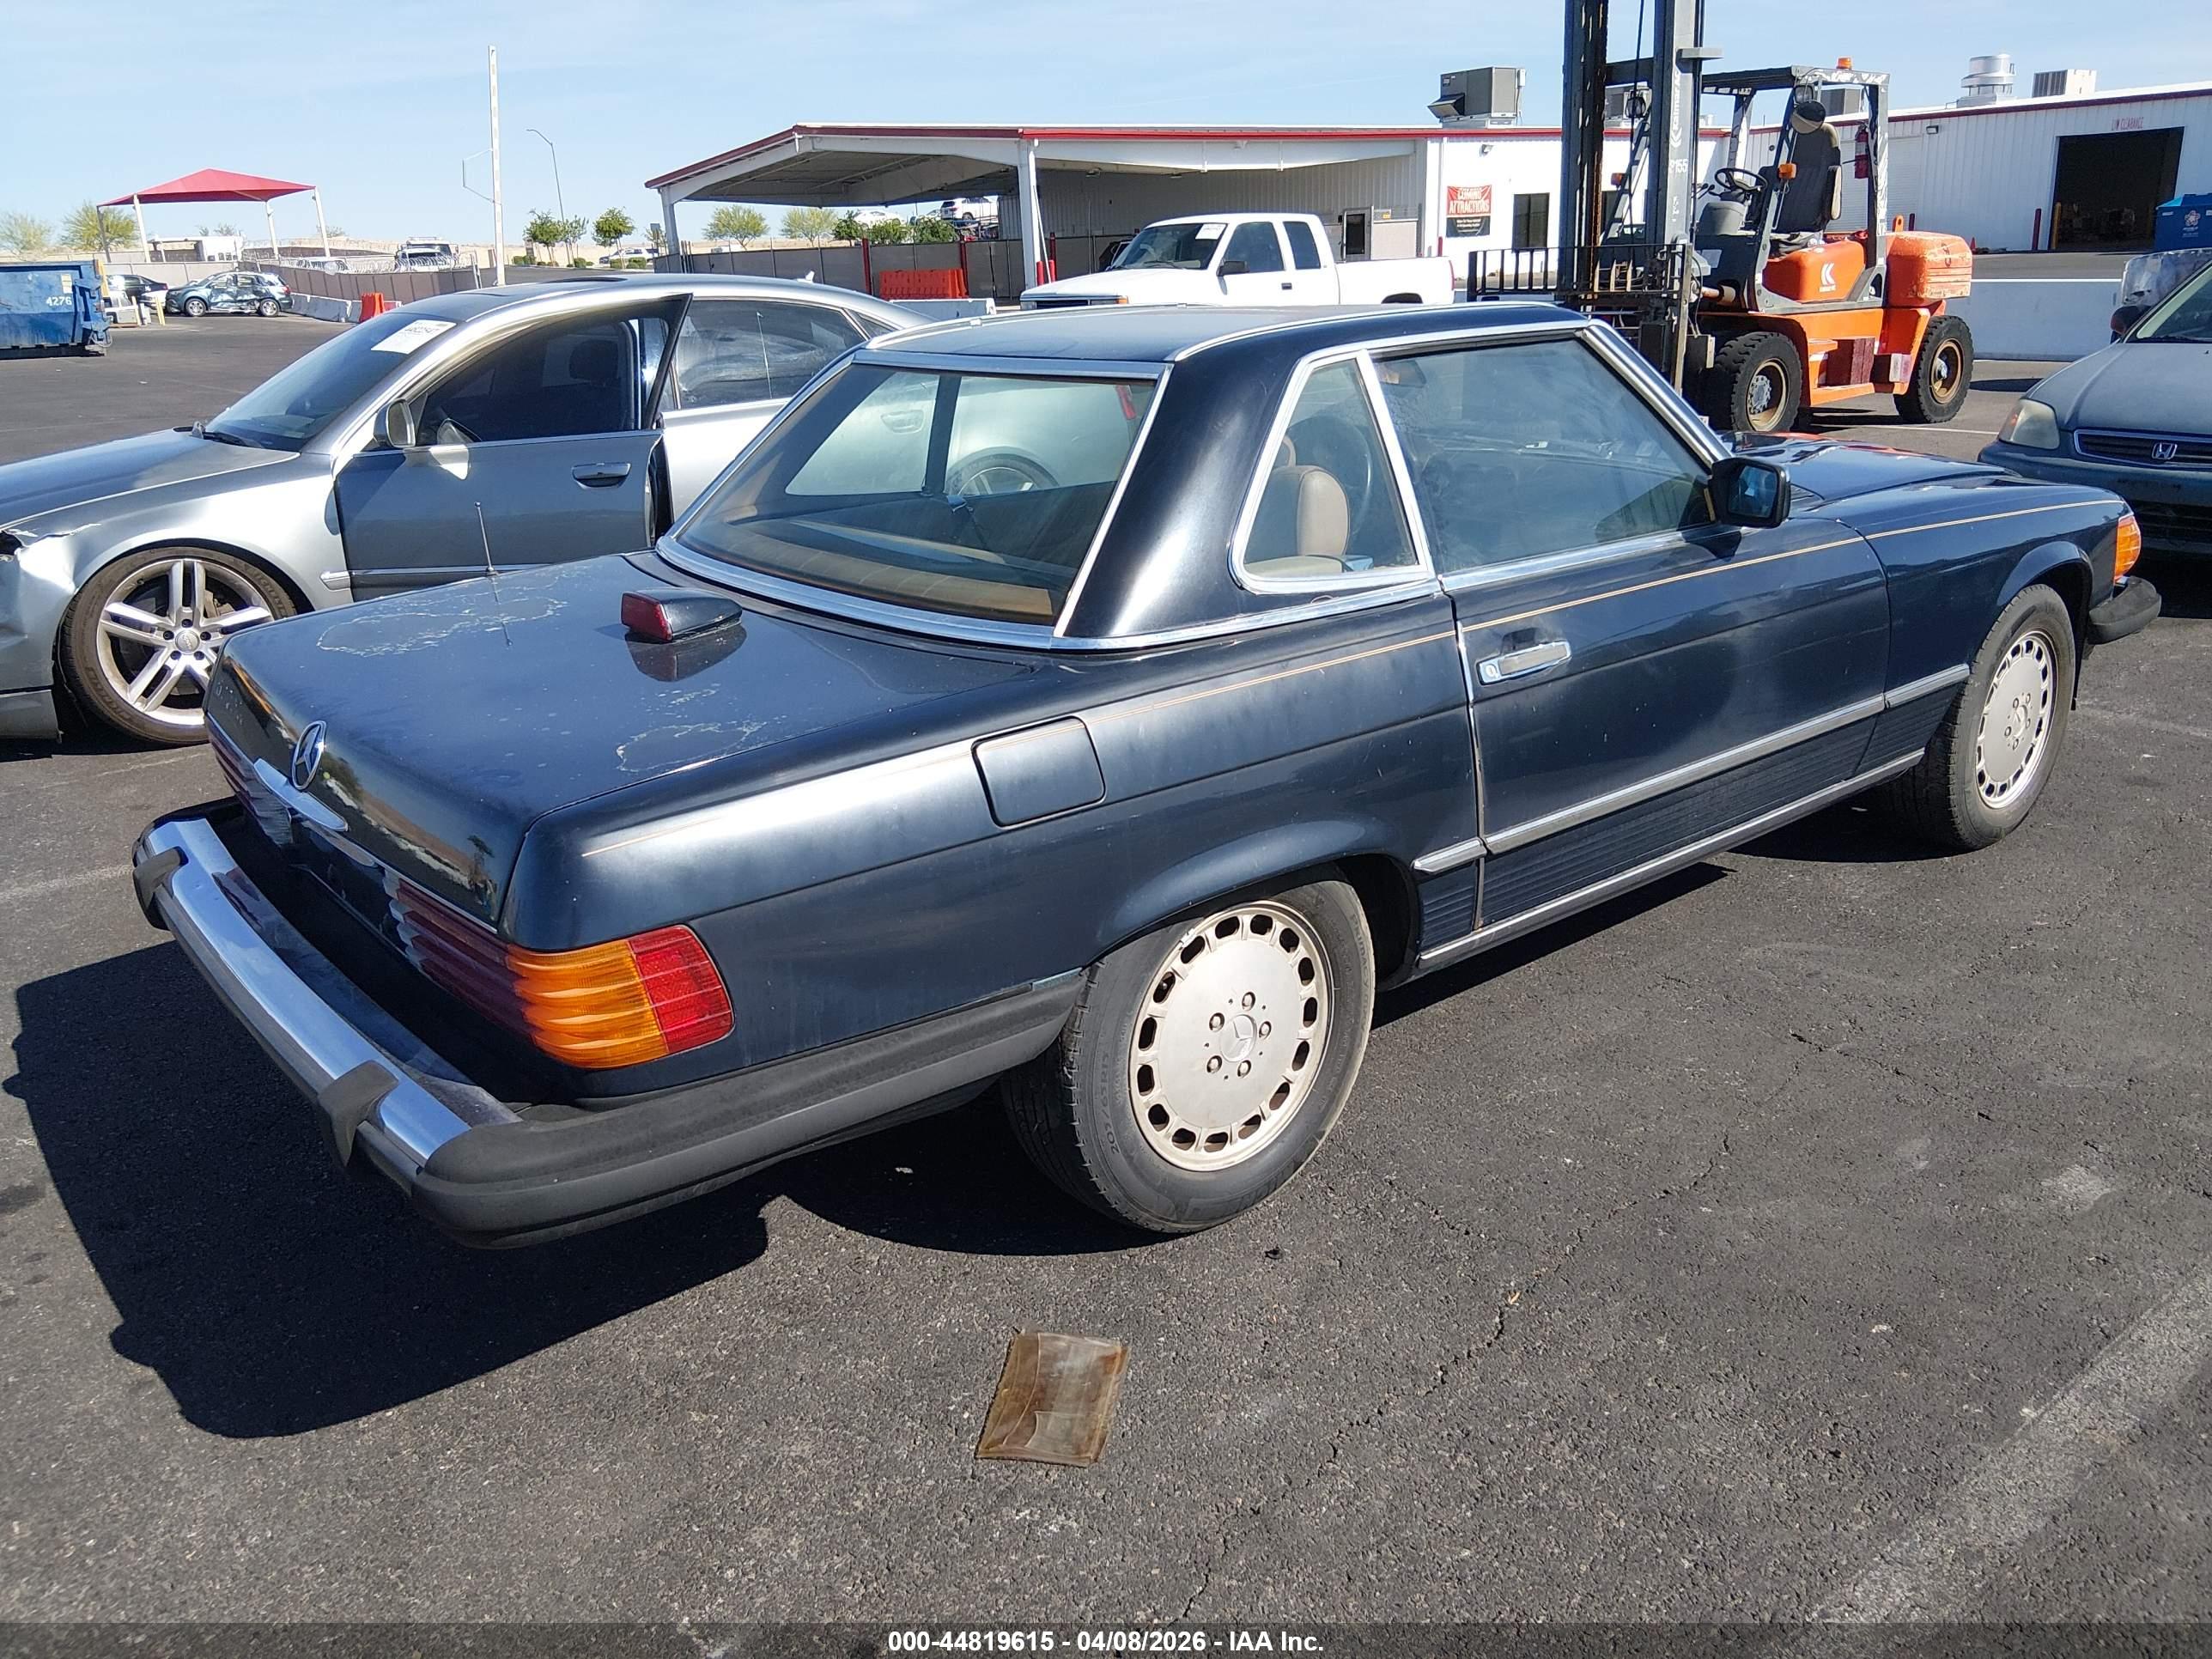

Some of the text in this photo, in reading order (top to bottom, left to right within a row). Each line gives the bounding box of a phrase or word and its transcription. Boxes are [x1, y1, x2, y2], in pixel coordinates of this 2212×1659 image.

[1457, 189, 1482, 199] COMING
[1449, 199, 1490, 214] ATTRACTIONS
[46, 296, 73, 307] 4276
[1350, 914, 1370, 988] PRIMACY
[1100, 1054, 1121, 1155] 205/65R15
